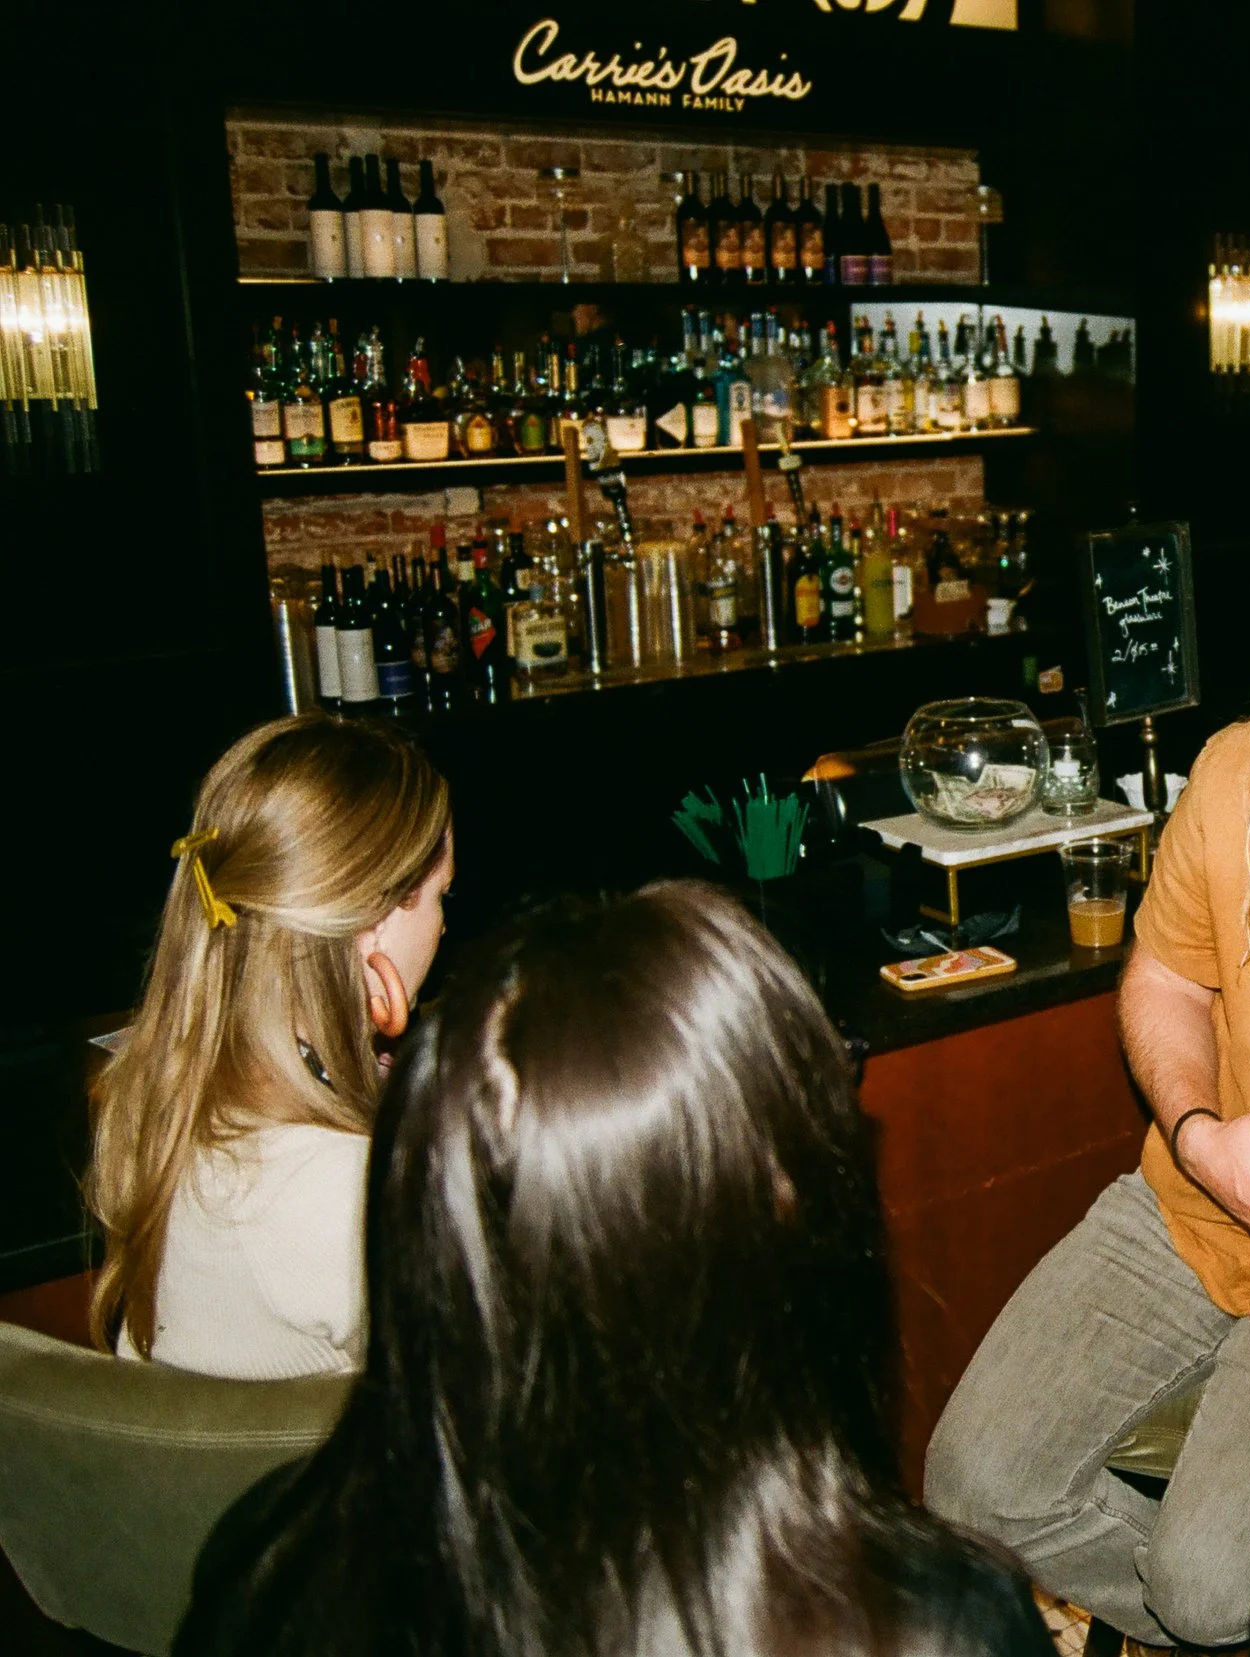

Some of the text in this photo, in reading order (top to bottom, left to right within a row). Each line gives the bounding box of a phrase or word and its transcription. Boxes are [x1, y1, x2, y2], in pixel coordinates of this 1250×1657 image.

[513, 18, 812, 99] Carrie's Oasis
[591, 88, 745, 112] HAMANN FAMILY
